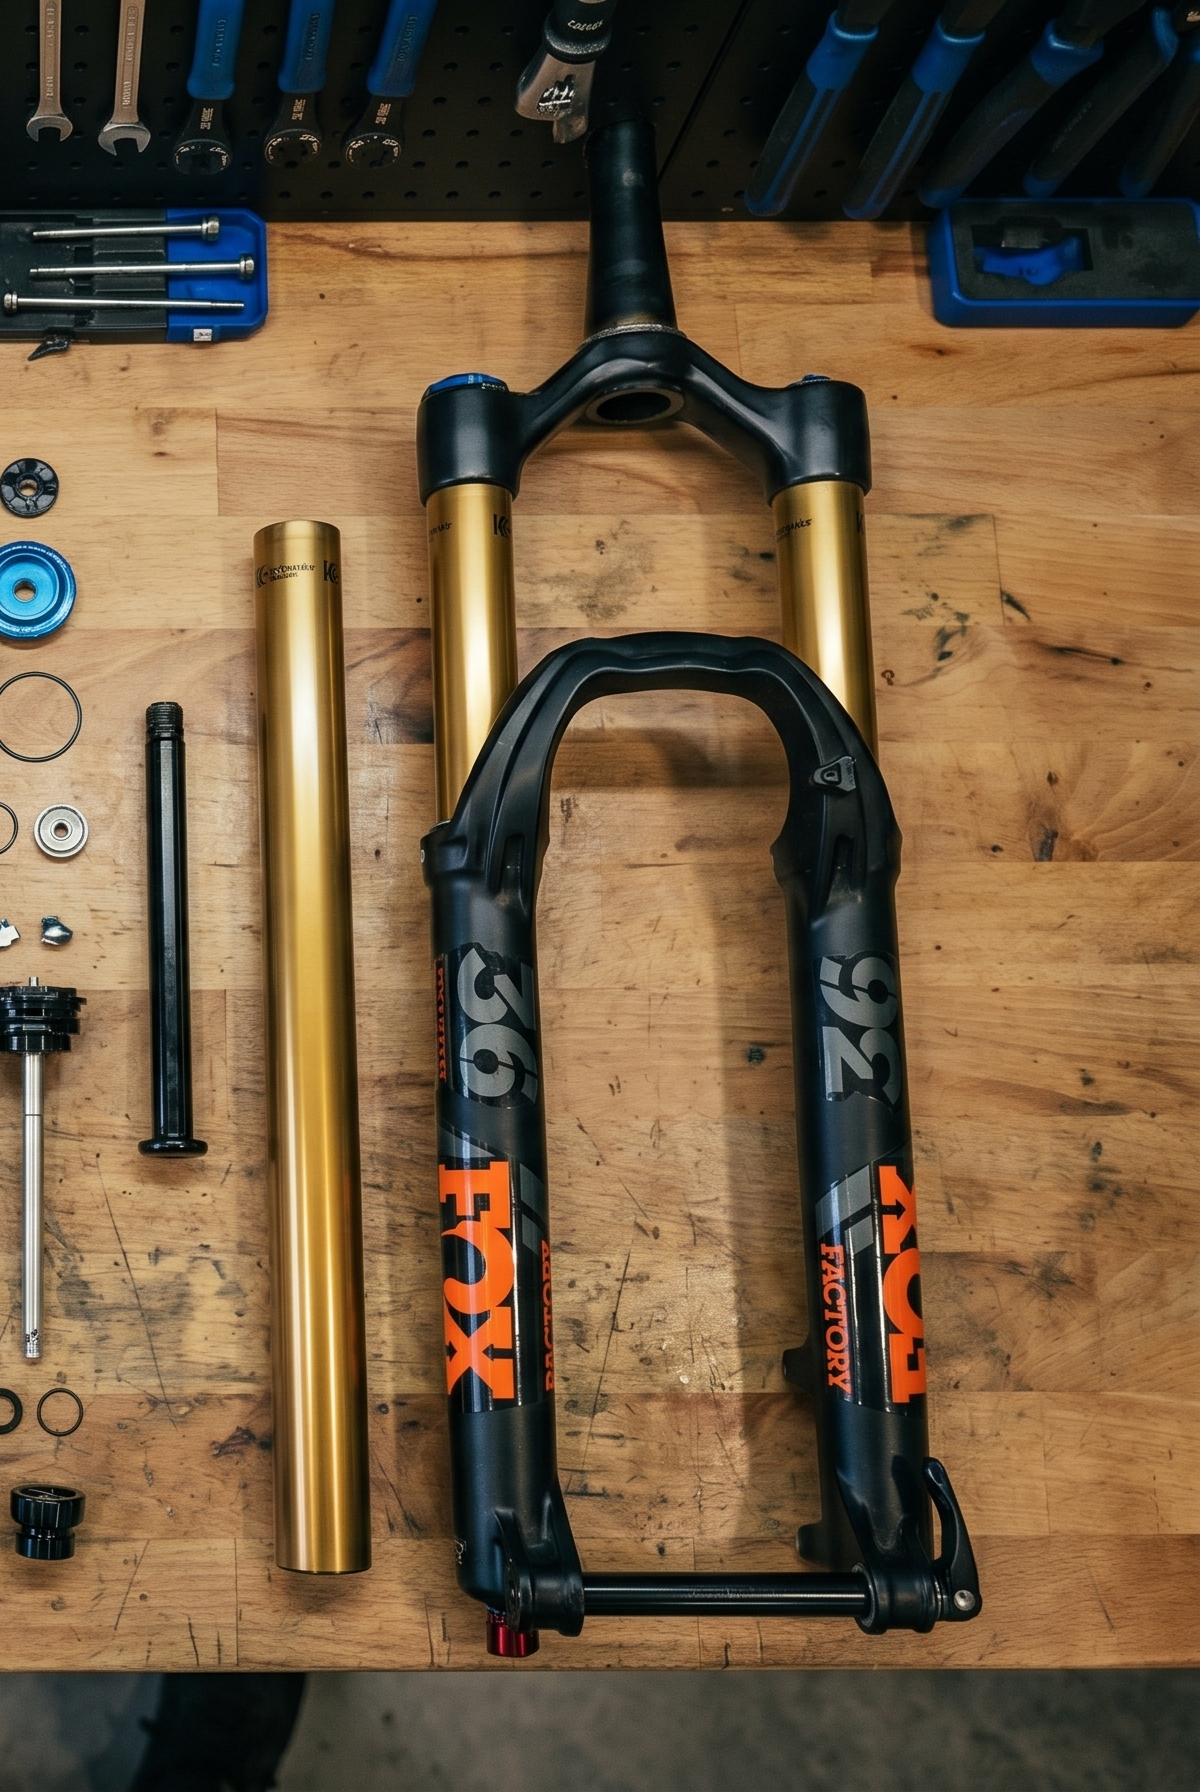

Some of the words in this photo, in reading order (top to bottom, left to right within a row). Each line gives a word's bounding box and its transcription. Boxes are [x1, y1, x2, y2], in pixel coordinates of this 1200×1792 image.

[457, 947, 538, 1104] 36
[819, 956, 901, 1106] 36
[438, 1161, 515, 1399] FOX
[820, 1243, 852, 1395] FACTORY
